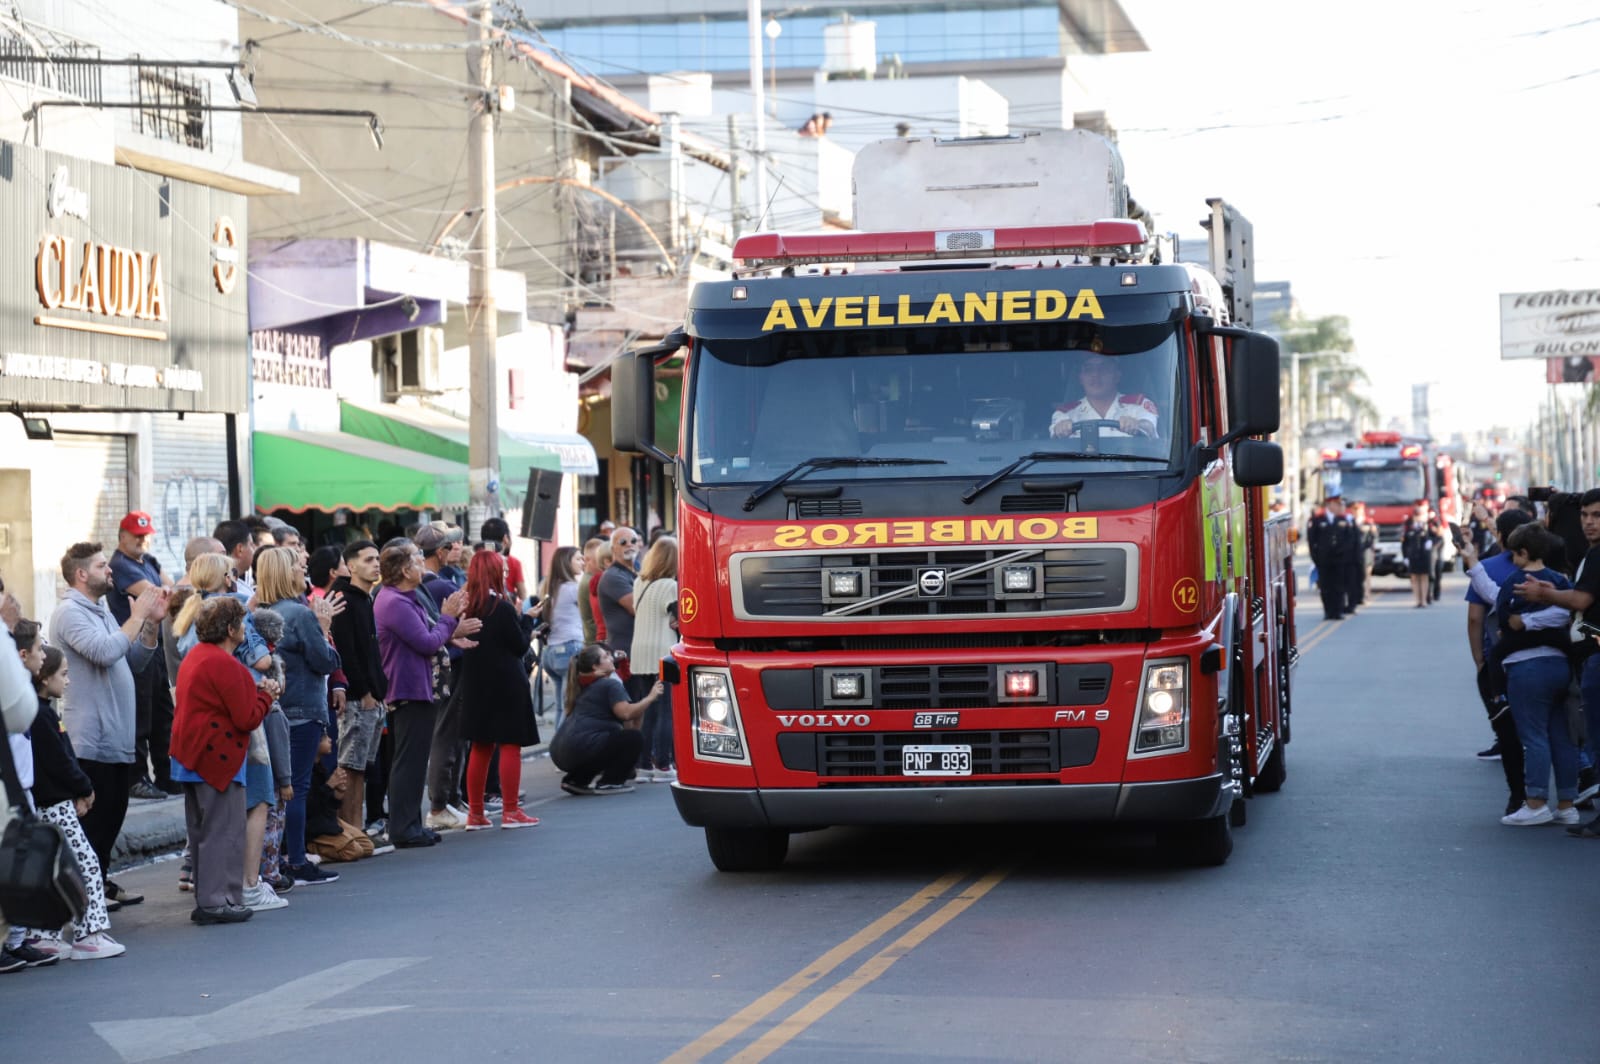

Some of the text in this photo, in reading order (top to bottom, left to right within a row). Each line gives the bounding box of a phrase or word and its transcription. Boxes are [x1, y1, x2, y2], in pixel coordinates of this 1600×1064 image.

[37, 234, 168, 321] CLAUDIA
[761, 289, 1105, 331] AVELLANEDA
[1178, 587, 1196, 604] 12
[681, 597, 694, 615] 12
[776, 714, 871, 727] VOLVO
[914, 714, 958, 725] GB Fire
[1054, 709, 1110, 722] FM 9
[905, 752, 969, 770] PNP 893
